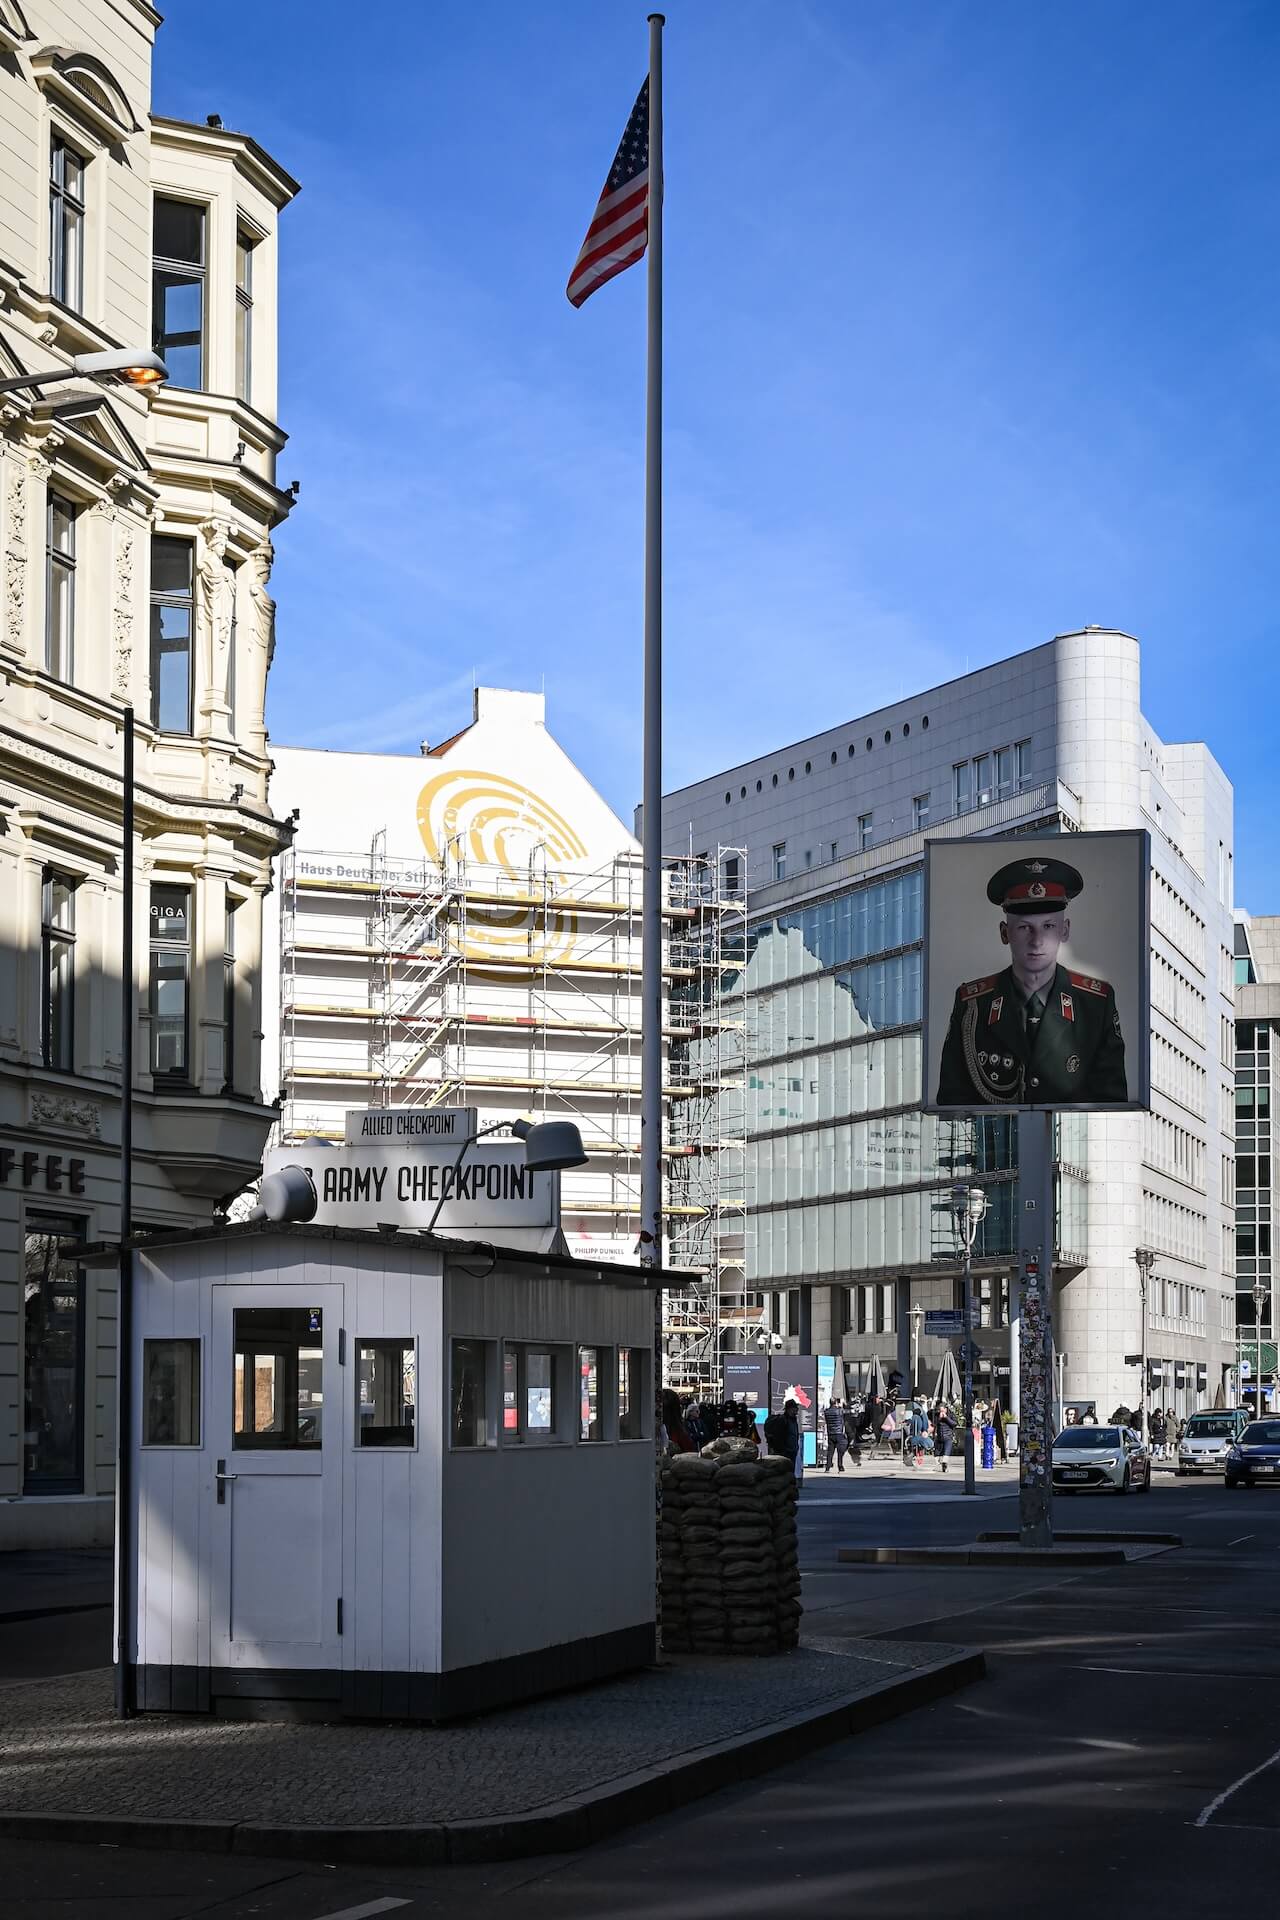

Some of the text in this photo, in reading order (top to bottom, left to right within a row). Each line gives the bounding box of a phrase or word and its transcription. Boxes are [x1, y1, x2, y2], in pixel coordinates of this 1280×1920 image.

[301, 862, 332, 875] Haus
[404, 870, 472, 890] Stiftgen
[150, 906, 184, 917] GIGA
[361, 1114, 456, 1135] ALLIED CHECKPOINT
[323, 1163, 535, 1202] ARMY CHECKPOINT
